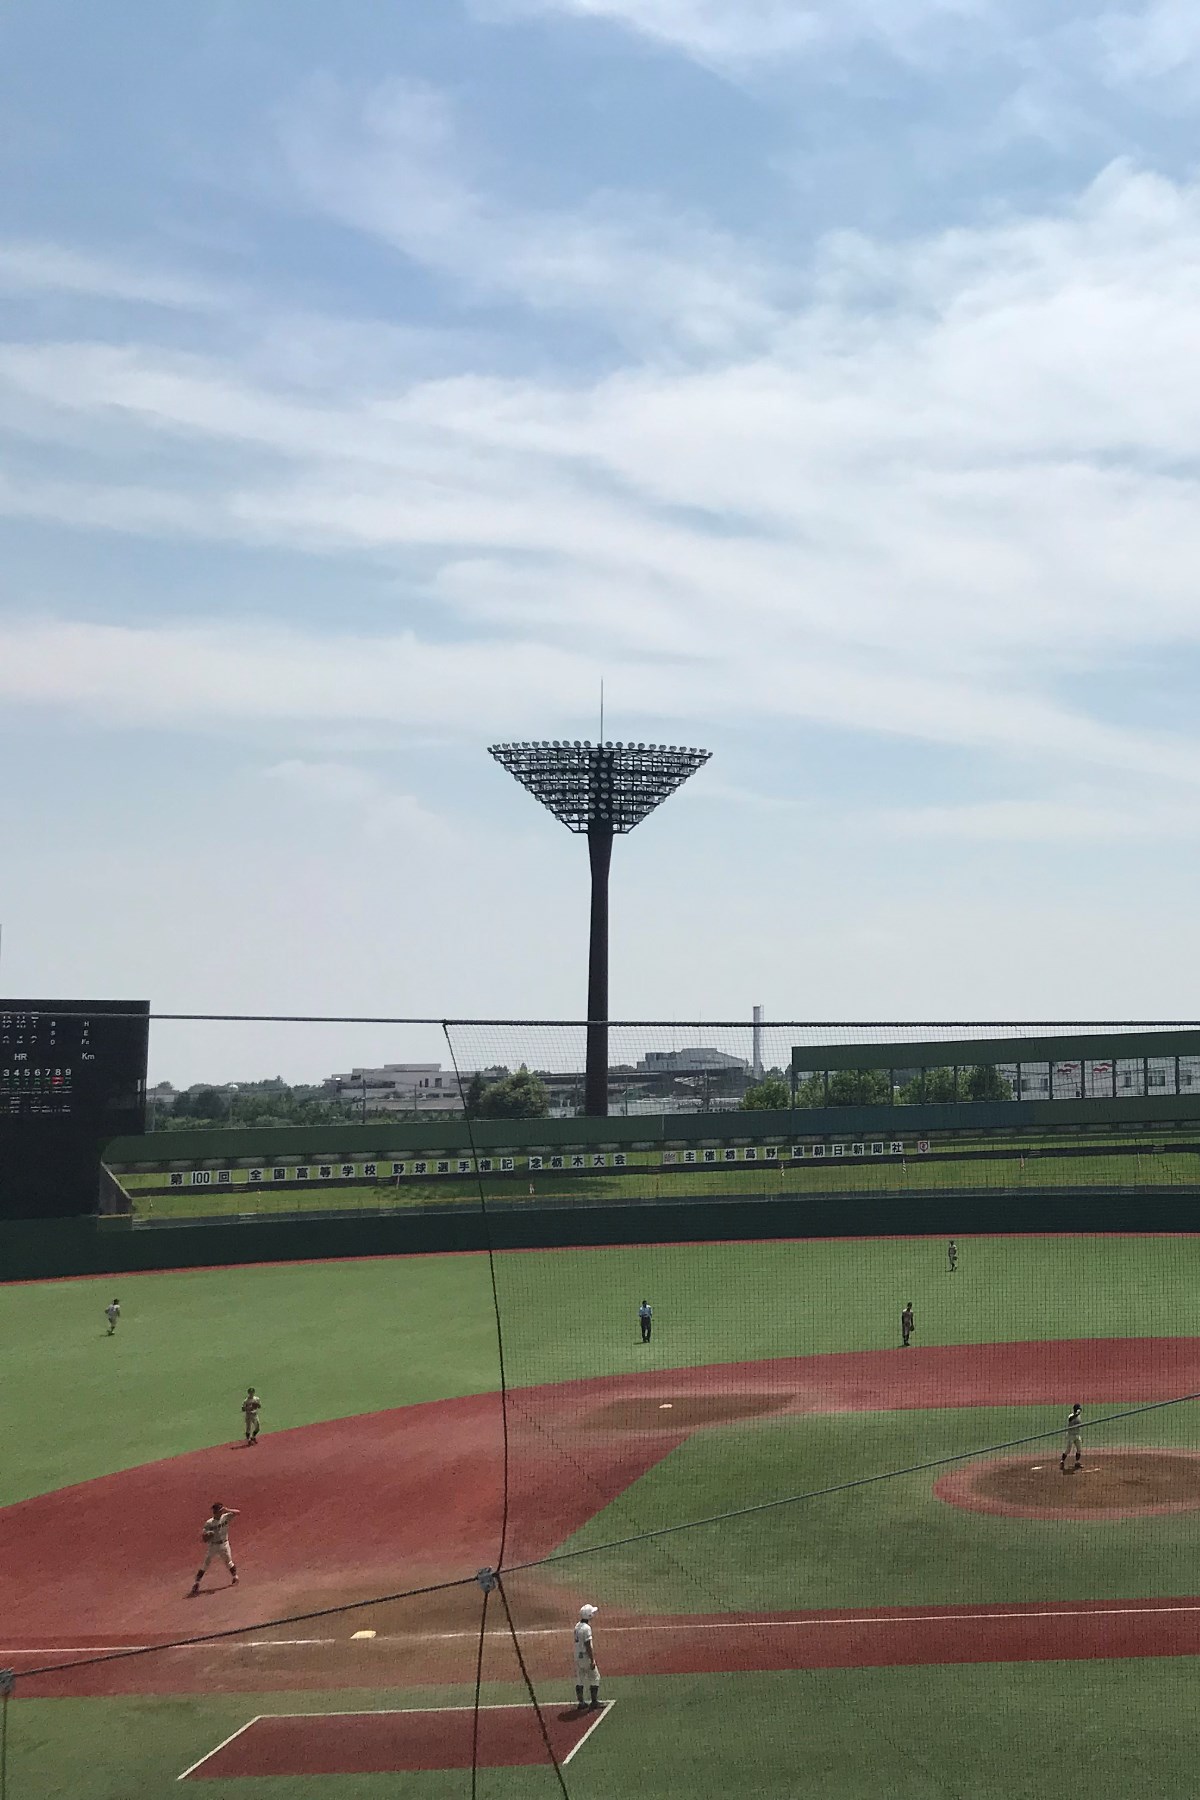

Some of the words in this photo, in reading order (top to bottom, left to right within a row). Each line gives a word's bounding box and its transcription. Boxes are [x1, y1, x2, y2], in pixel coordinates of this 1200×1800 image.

[81, 1052, 95, 1060] Km
[3, 1068, 10, 1076] 3
[13, 1068, 20, 1076] 4
[24, 1068, 30, 1076] 5
[34, 1068, 41, 1076] 6
[44, 1068, 51, 1076] 7
[55, 1068, 61, 1076] 8
[65, 1068, 71, 1076] 9
